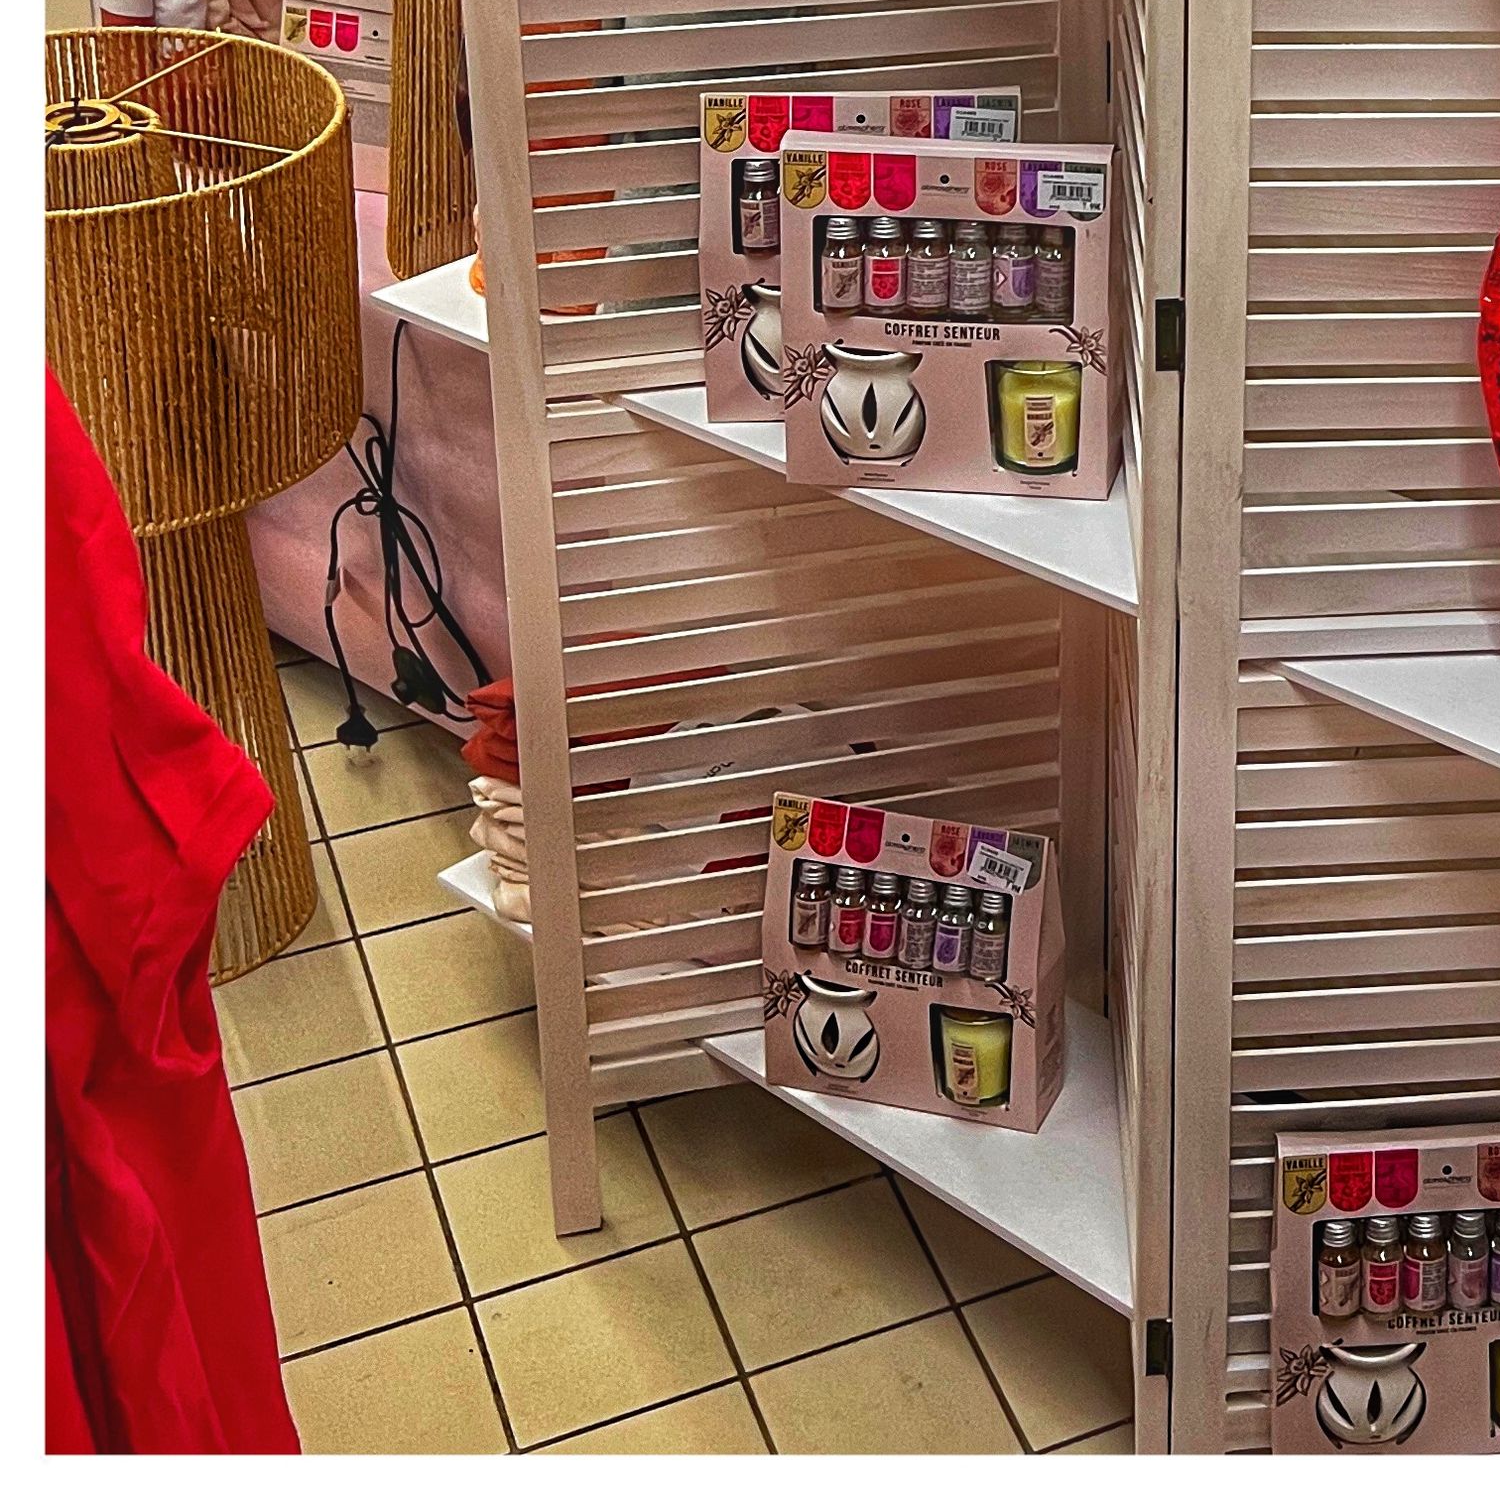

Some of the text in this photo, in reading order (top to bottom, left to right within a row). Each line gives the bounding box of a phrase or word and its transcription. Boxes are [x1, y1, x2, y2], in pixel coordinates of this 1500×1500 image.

[707, 98, 744, 108] VANILLE
[901, 99, 922, 109] ROSE
[786, 153, 824, 165] VANILLE
[984, 161, 1007, 171] ROSE
[885, 323, 1000, 340] COFFRET SENTEUR
[778, 799, 809, 812] VANILLE
[941, 824, 960, 836] ROSE
[845, 960, 944, 989] COFFRET SENTEUR
[1287, 1157, 1324, 1171] VANILLE
[1388, 1311, 1445, 1330] COFFRET
